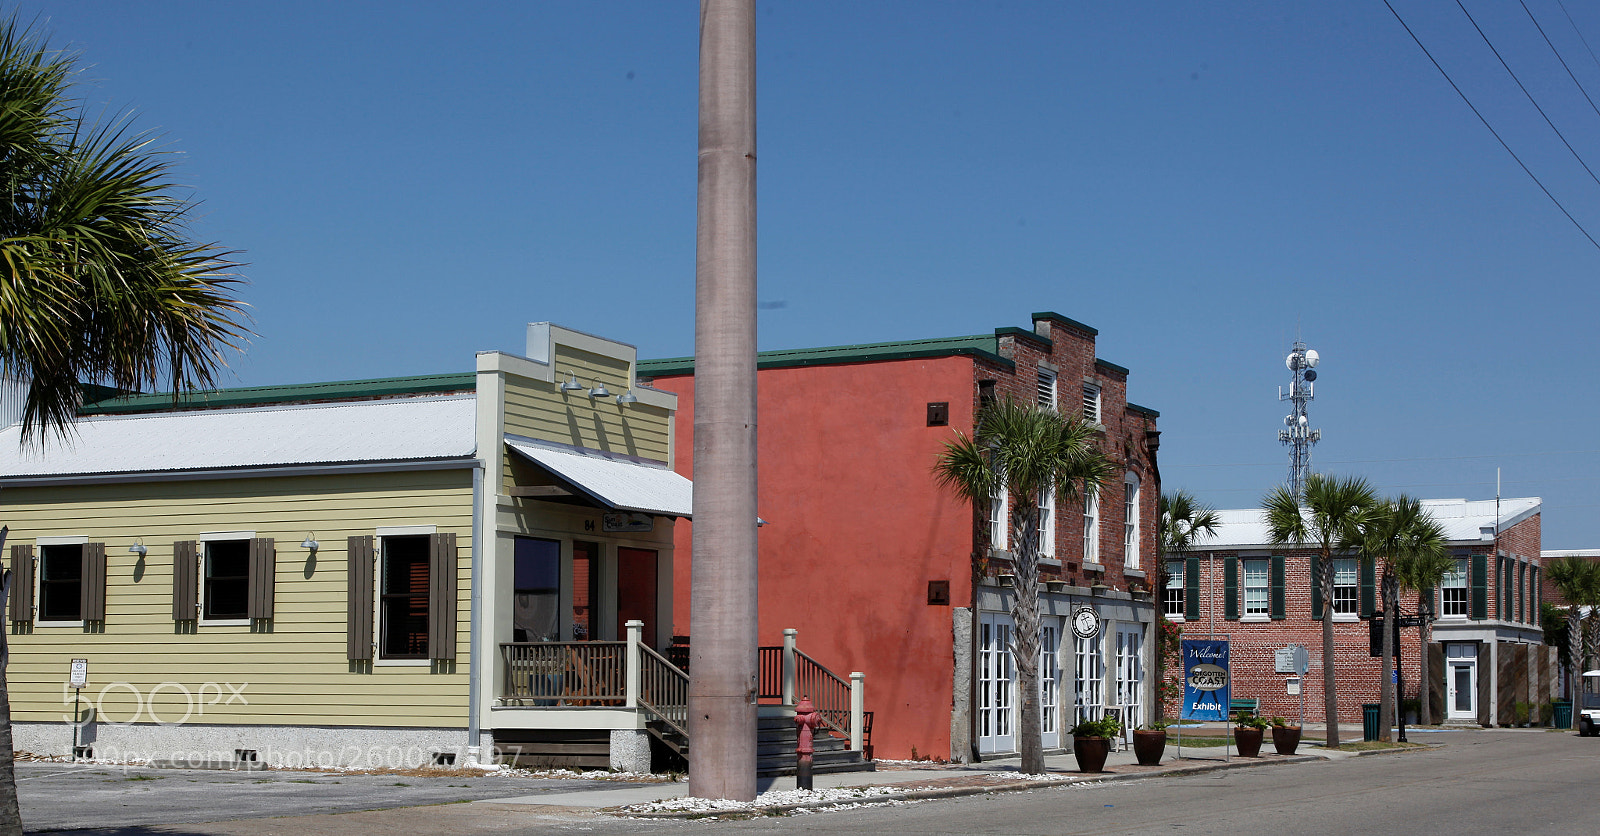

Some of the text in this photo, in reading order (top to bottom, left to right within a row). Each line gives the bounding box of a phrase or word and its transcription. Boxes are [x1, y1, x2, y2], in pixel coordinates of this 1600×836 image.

[584, 520, 595, 531] 84
[1189, 645, 1227, 659] Welcome!
[1192, 676, 1226, 686] COAST
[1192, 702, 1222, 711] Exhibit
